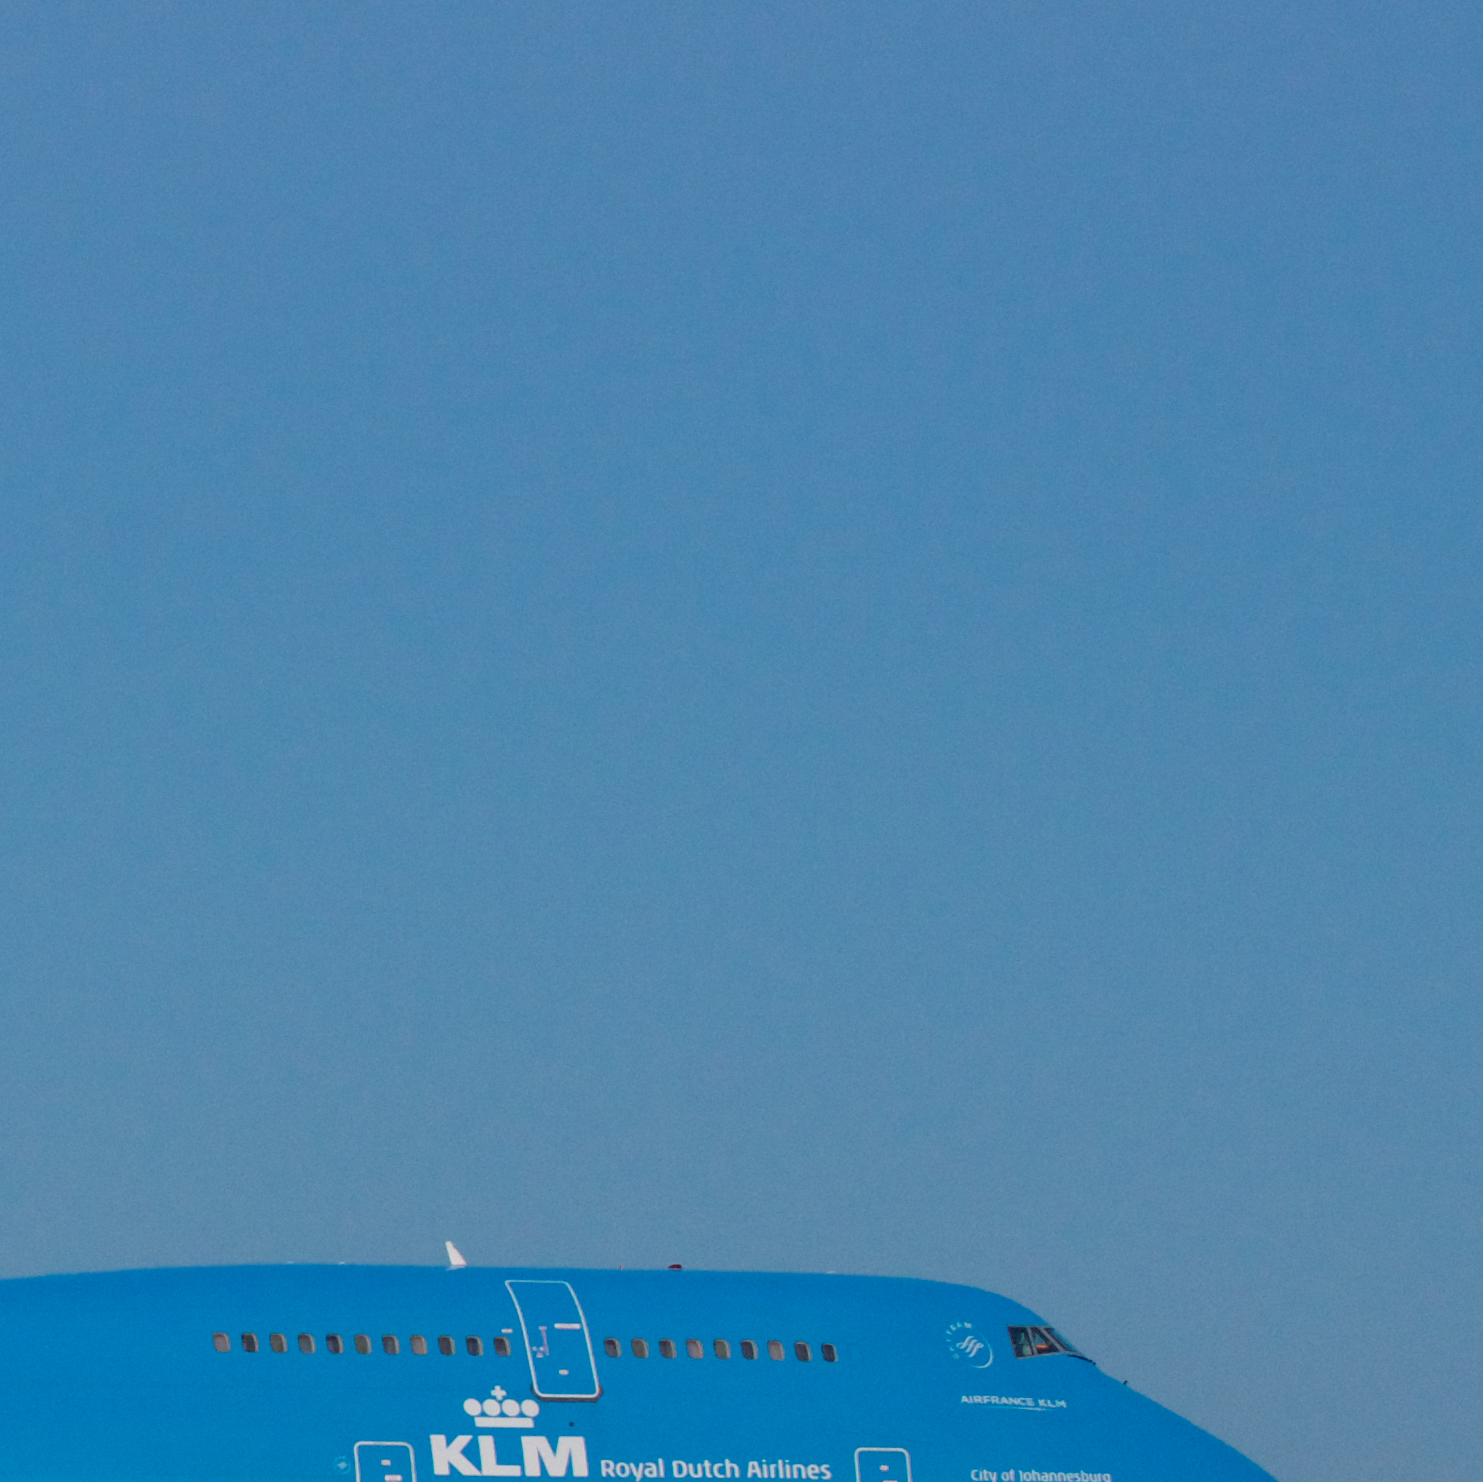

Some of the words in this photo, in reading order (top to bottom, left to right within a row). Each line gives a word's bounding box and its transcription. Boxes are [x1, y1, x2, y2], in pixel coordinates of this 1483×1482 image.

[961, 1395, 1035, 1406] AIRFRANCE
[1038, 1399, 1067, 1409] KLM
[430, 1434, 590, 1477] KLM
[601, 1458, 665, 1481] Royal
[673, 1459, 740, 1479] Dutch
[747, 1460, 832, 1480] Airlines
[1001, 1469, 1015, 1482] of
